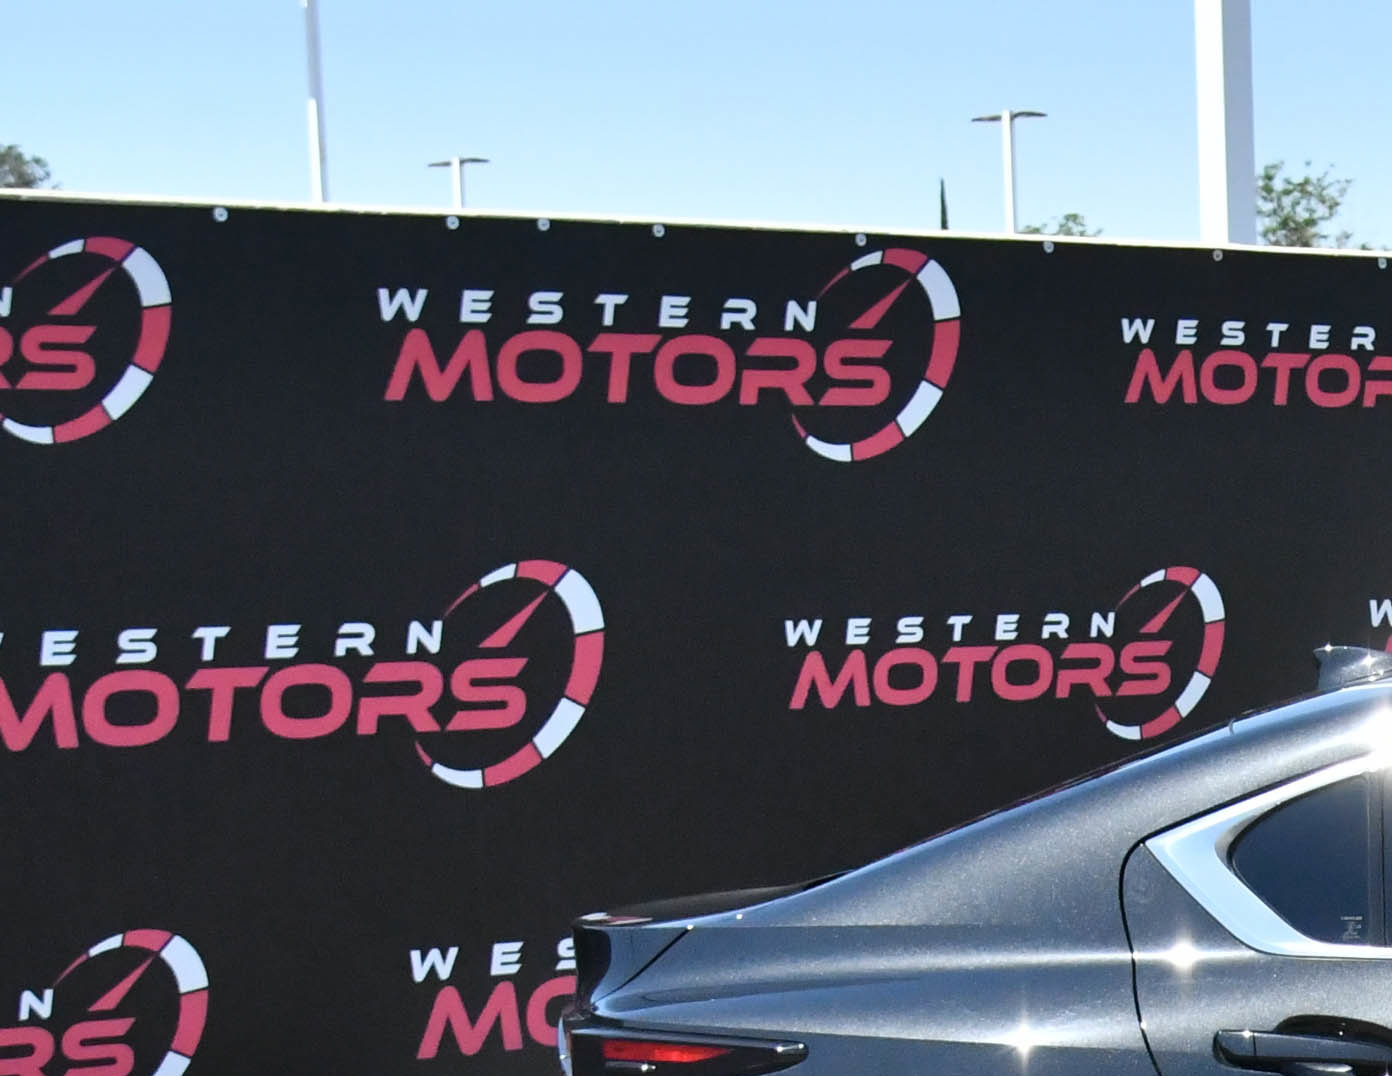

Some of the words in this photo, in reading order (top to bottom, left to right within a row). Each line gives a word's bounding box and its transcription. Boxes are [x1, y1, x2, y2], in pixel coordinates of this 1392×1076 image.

[379, 289, 816, 332] WESTERN
[384, 329, 893, 406] MOTORS
[0, 621, 443, 666] ESTERN
[785, 611, 1116, 647] WESTERN
[789, 641, 1172, 710] MOTORS
[0, 658, 528, 752] MOTORS
